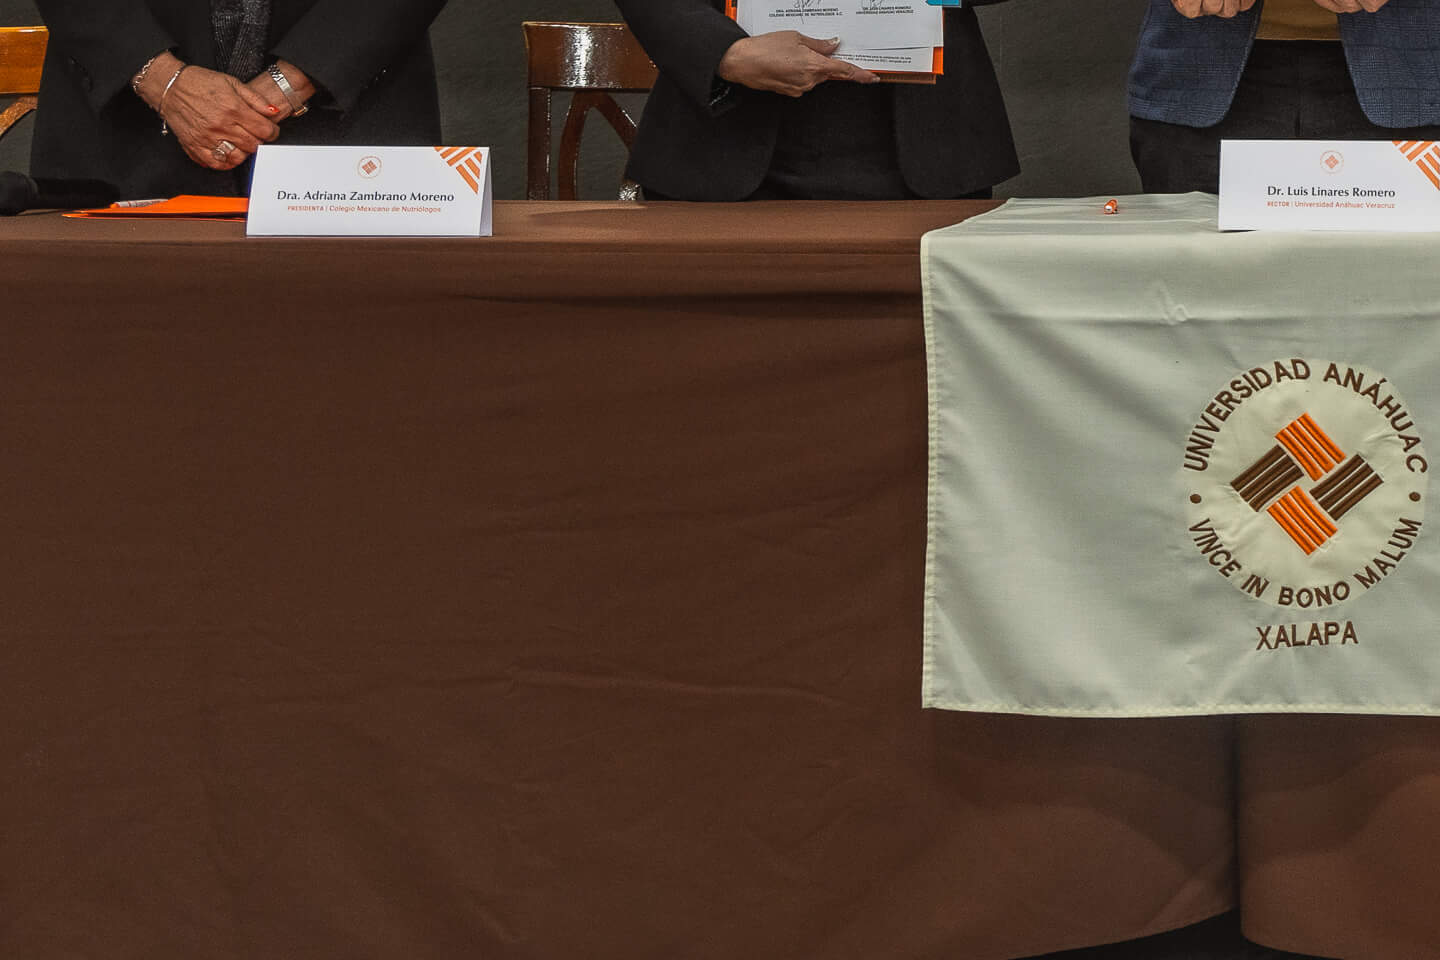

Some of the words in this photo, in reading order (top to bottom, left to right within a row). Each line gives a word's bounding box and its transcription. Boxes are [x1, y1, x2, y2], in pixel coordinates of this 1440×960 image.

[276, 190, 301, 201] Dra.
[303, 190, 347, 201] Adriana
[349, 191, 407, 202] Zambrano
[409, 191, 455, 202] Moreno
[1267, 186, 1285, 196] Dr.
[1287, 186, 1309, 197] Luis
[1311, 187, 1350, 198] Linares
[1352, 188, 1396, 198] Romero
[329, 205, 355, 214] Colegio
[356, 205, 391, 213] Mexicano
[391, 205, 401, 213] de
[1294, 201, 1334, 209] Universidad
[1183, 359, 1312, 472] UNIVERSIDAD
[1322, 362, 1428, 473] ANÁHUAC
[1188, 517, 1242, 579] VINCE
[1240, 573, 1270, 598] IN
[1277, 581, 1351, 609] BONO
[1352, 517, 1422, 590] MALUM
[1255, 620, 1359, 651] XALAPA
